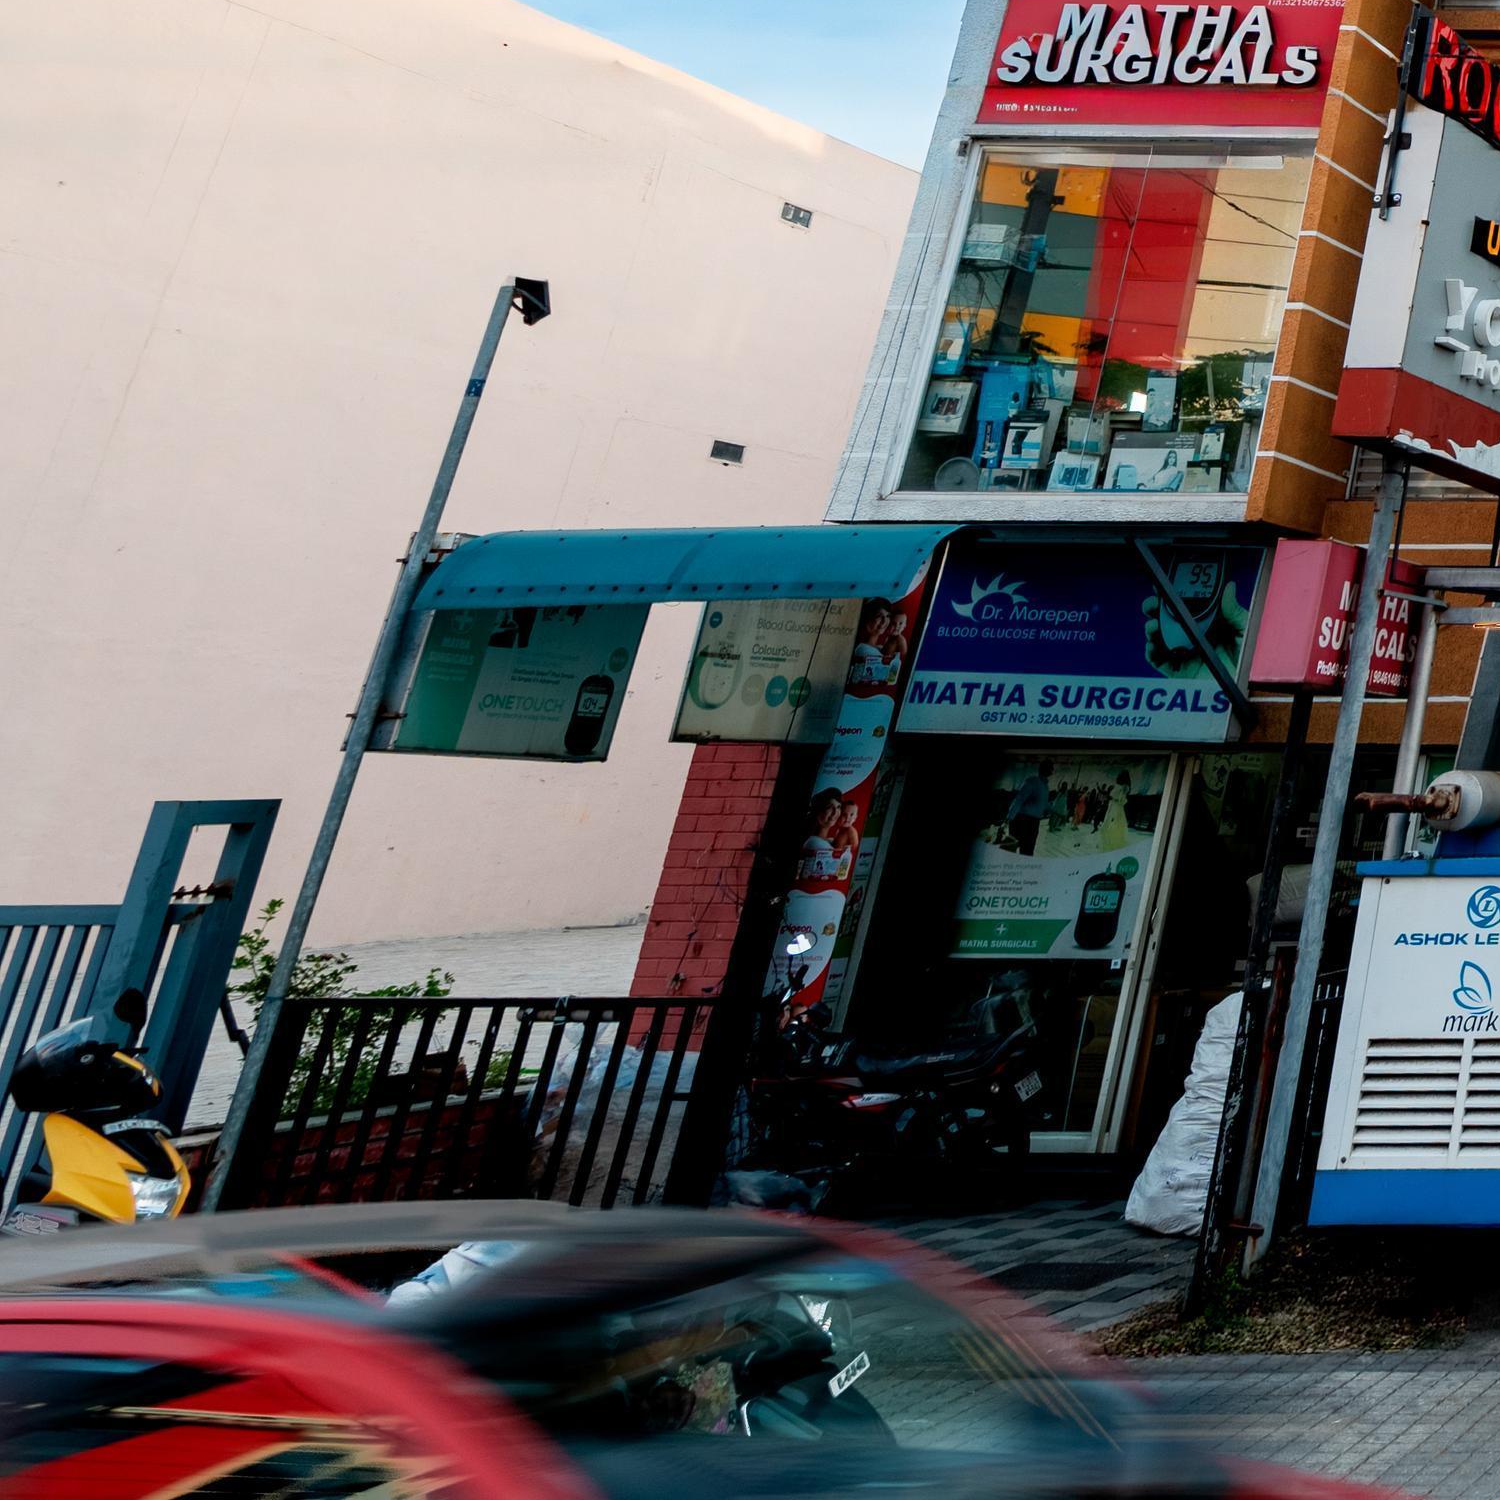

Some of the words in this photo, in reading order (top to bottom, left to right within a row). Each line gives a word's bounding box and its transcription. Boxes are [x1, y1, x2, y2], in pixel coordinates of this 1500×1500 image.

[1056, 3, 1274, 54] MATHA
[996, 36, 1320, 86] SURGICALS
[1189, 563, 1213, 585] 95
[981, 603, 1004, 621] Dr.
[1009, 604, 1090, 625] Morepen
[757, 618, 783, 631] Blood
[937, 626, 978, 638] BLOOD
[981, 627, 1036, 640] GLUCOSE
[1039, 629, 1097, 641] MONITOR
[482, 693, 564, 713] ONETOUCH
[908, 680, 1027, 708] MATHA
[1038, 684, 1232, 714] SURGICALS
[980, 710, 1006, 723] GST
[1008, 711, 1028, 724] NO
[968, 895, 1049, 910] ONETOUCH
[1089, 893, 1109, 907] 104
[959, 938, 989, 948] MATHA
[990, 939, 1038, 949] SURGICALS
[1393, 932, 1470, 947] ASHOK
[1442, 1009, 1499, 1033] mark
